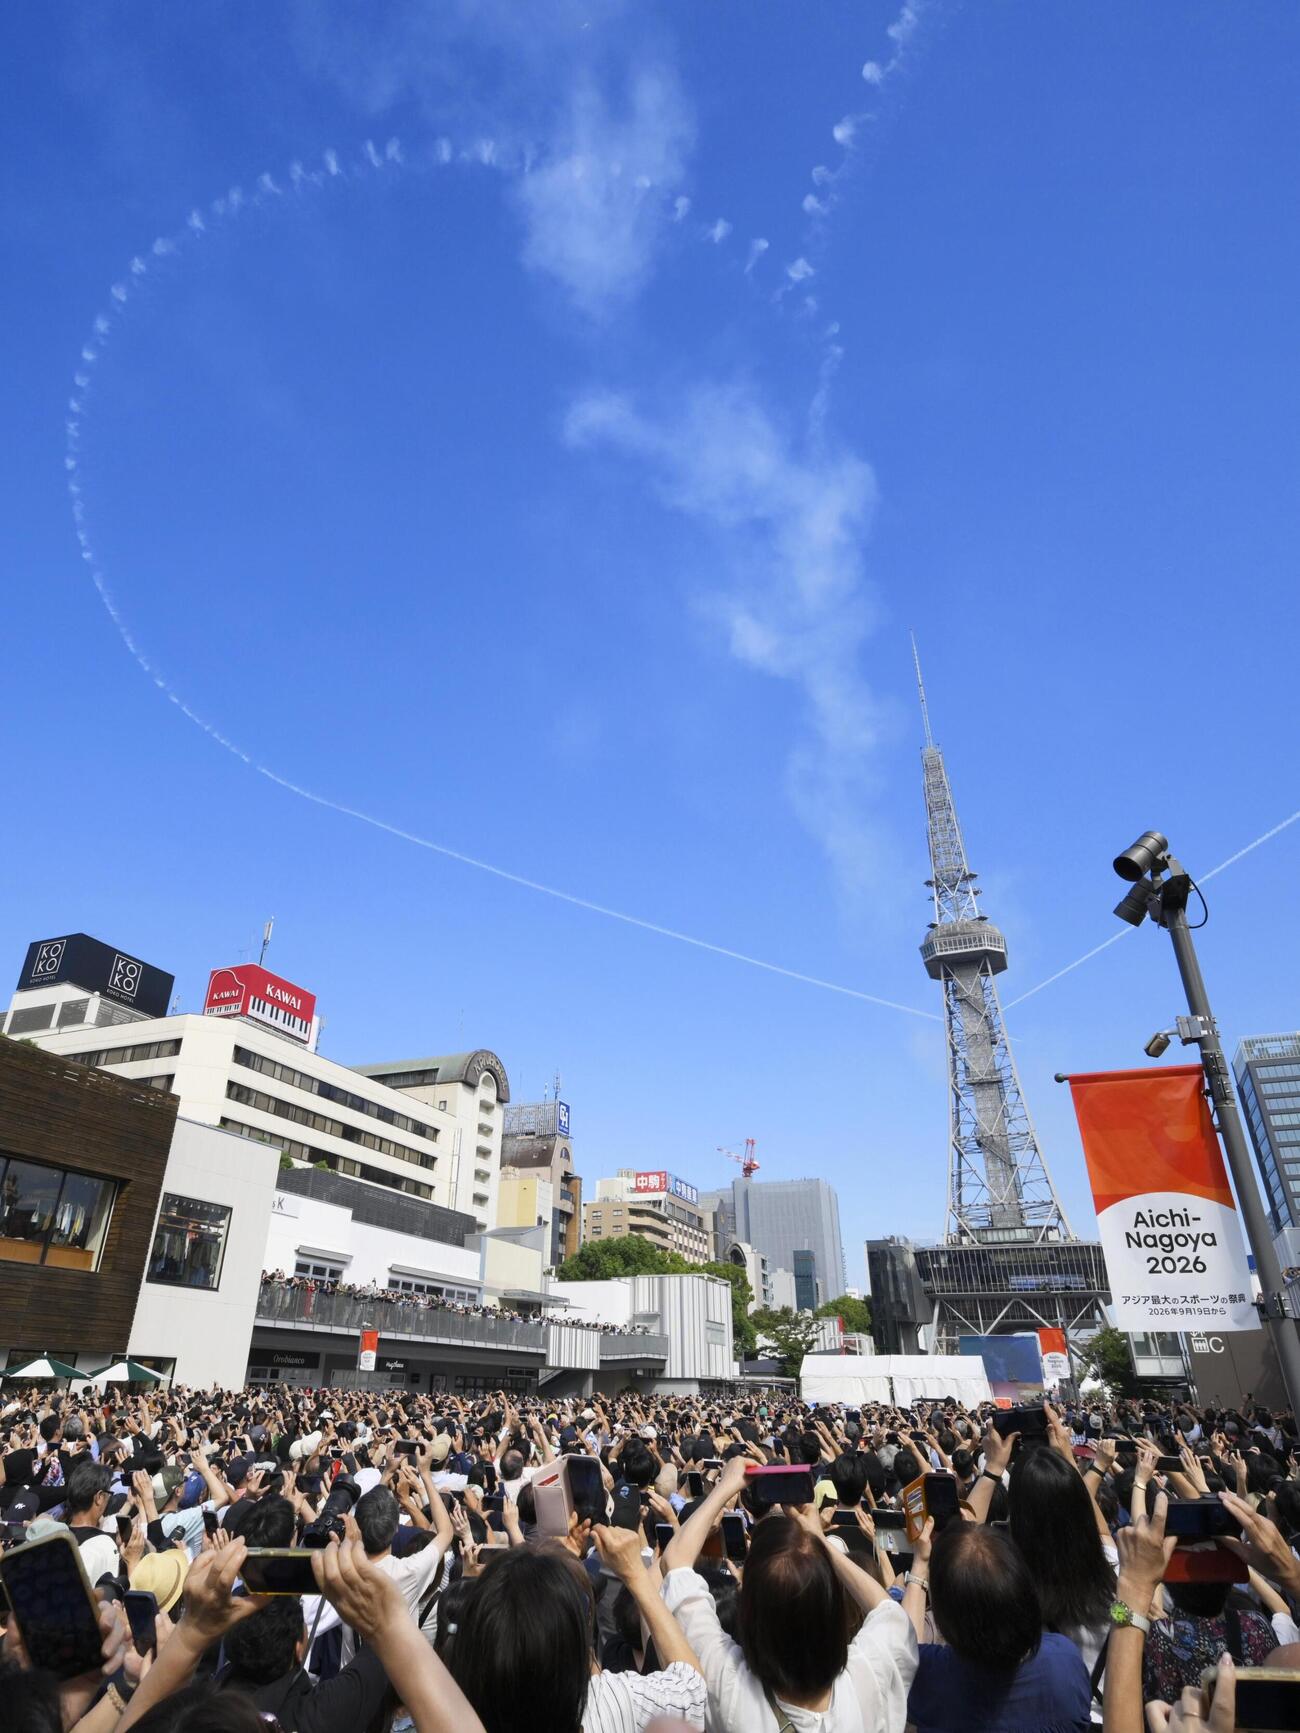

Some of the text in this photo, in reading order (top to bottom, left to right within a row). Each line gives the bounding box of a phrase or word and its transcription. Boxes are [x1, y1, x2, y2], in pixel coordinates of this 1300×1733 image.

[212, 989, 239, 1000] KAWAI
[266, 984, 302, 1010] KAWAI
[1134, 1208, 1201, 1228] Aichi-
[1125, 1231, 1217, 1253] Nagoya
[1146, 1256, 1207, 1274] 2026
[1122, 1294, 1246, 1305] アジア最大のスポーツの祭典
[1148, 1307, 1227, 1316] 2026年9月19日から
